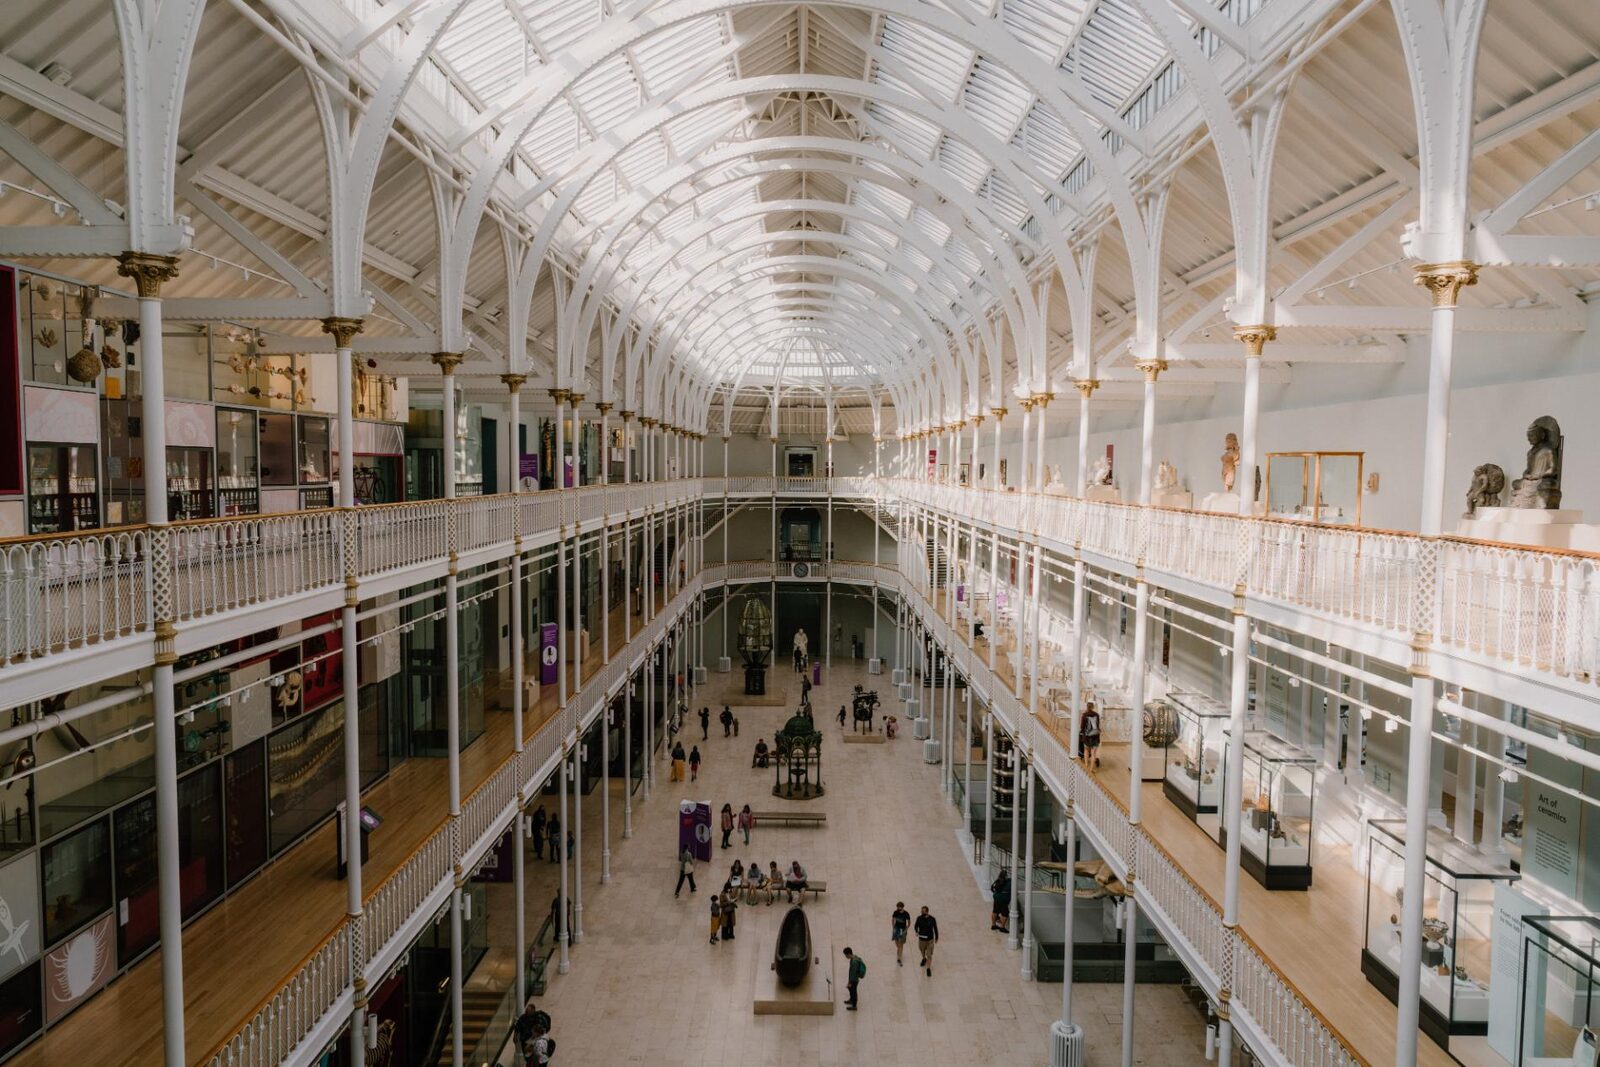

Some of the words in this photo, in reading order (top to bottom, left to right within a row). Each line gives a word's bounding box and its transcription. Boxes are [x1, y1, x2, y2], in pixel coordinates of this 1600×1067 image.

[1539, 793, 1549, 805] Art
[1550, 800, 1558, 808] of
[1538, 805, 1567, 824] ceramics
